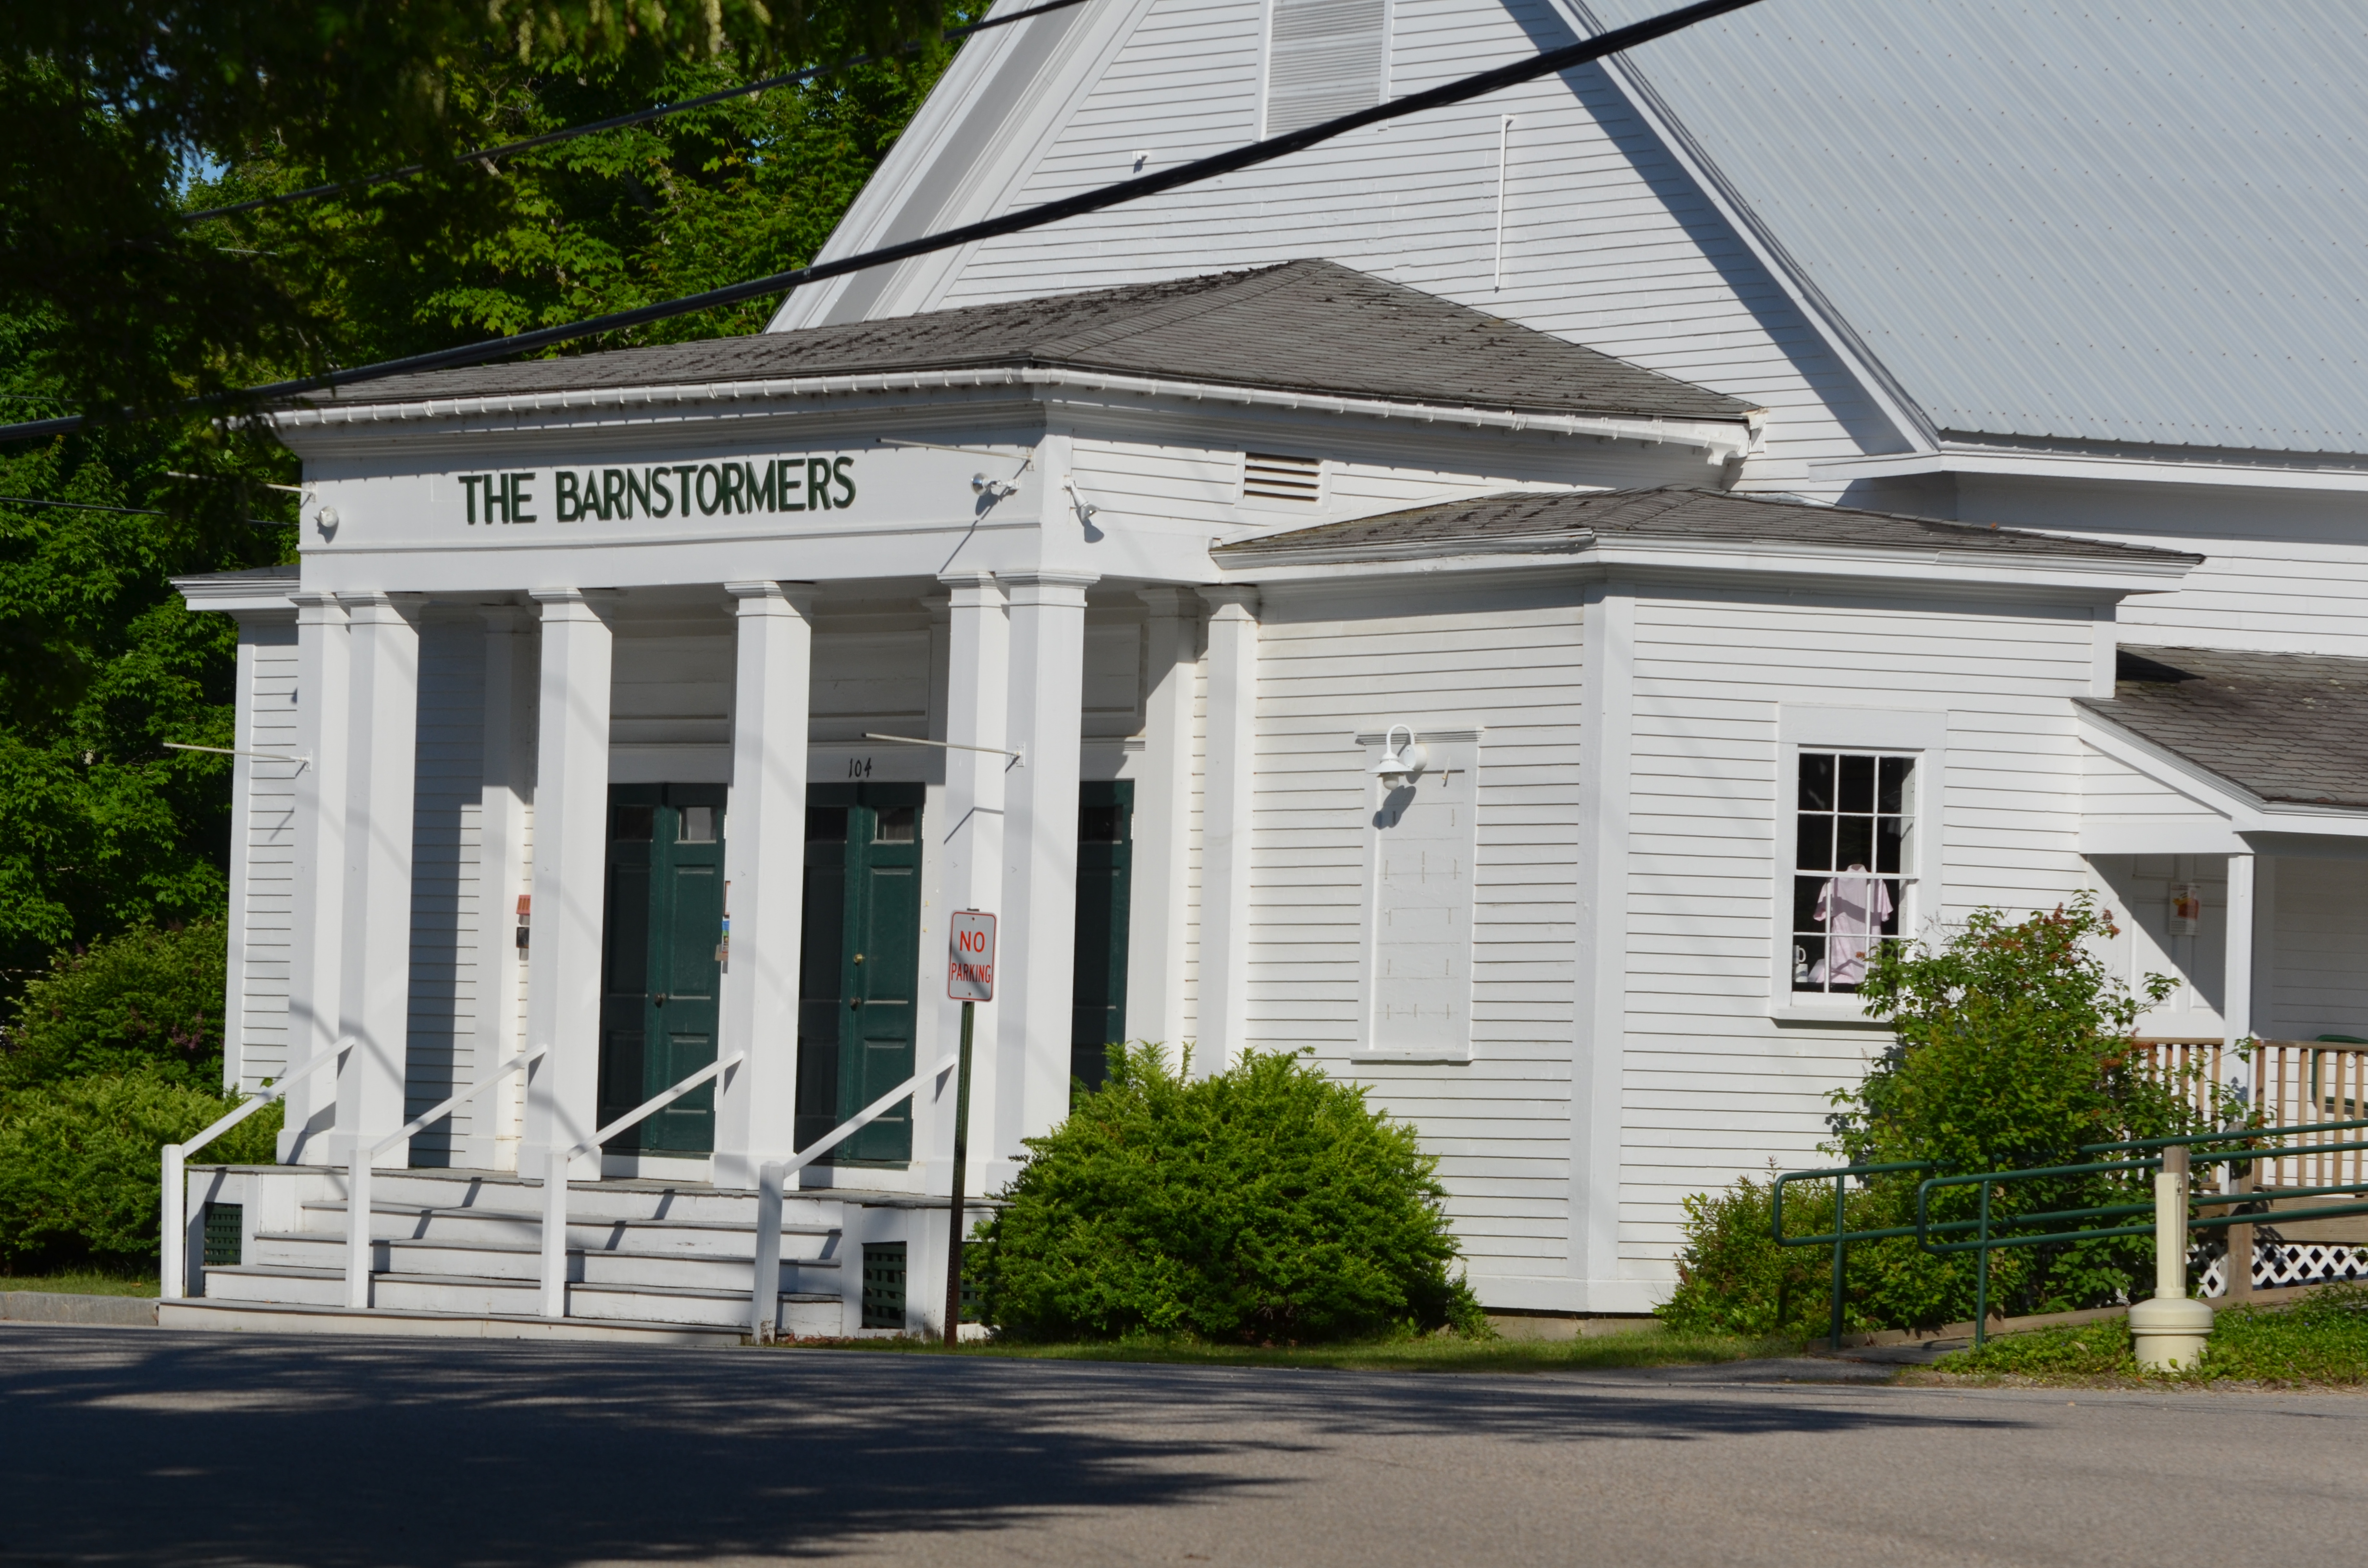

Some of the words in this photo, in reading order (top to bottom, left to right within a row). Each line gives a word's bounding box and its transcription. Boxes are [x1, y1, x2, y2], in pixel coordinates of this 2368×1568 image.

[458, 472, 537, 525] THE
[555, 456, 857, 523] BARNSTORMERS
[849, 758, 872, 778] 104
[960, 931, 986, 953] NO
[951, 962, 991, 983] PARKING
